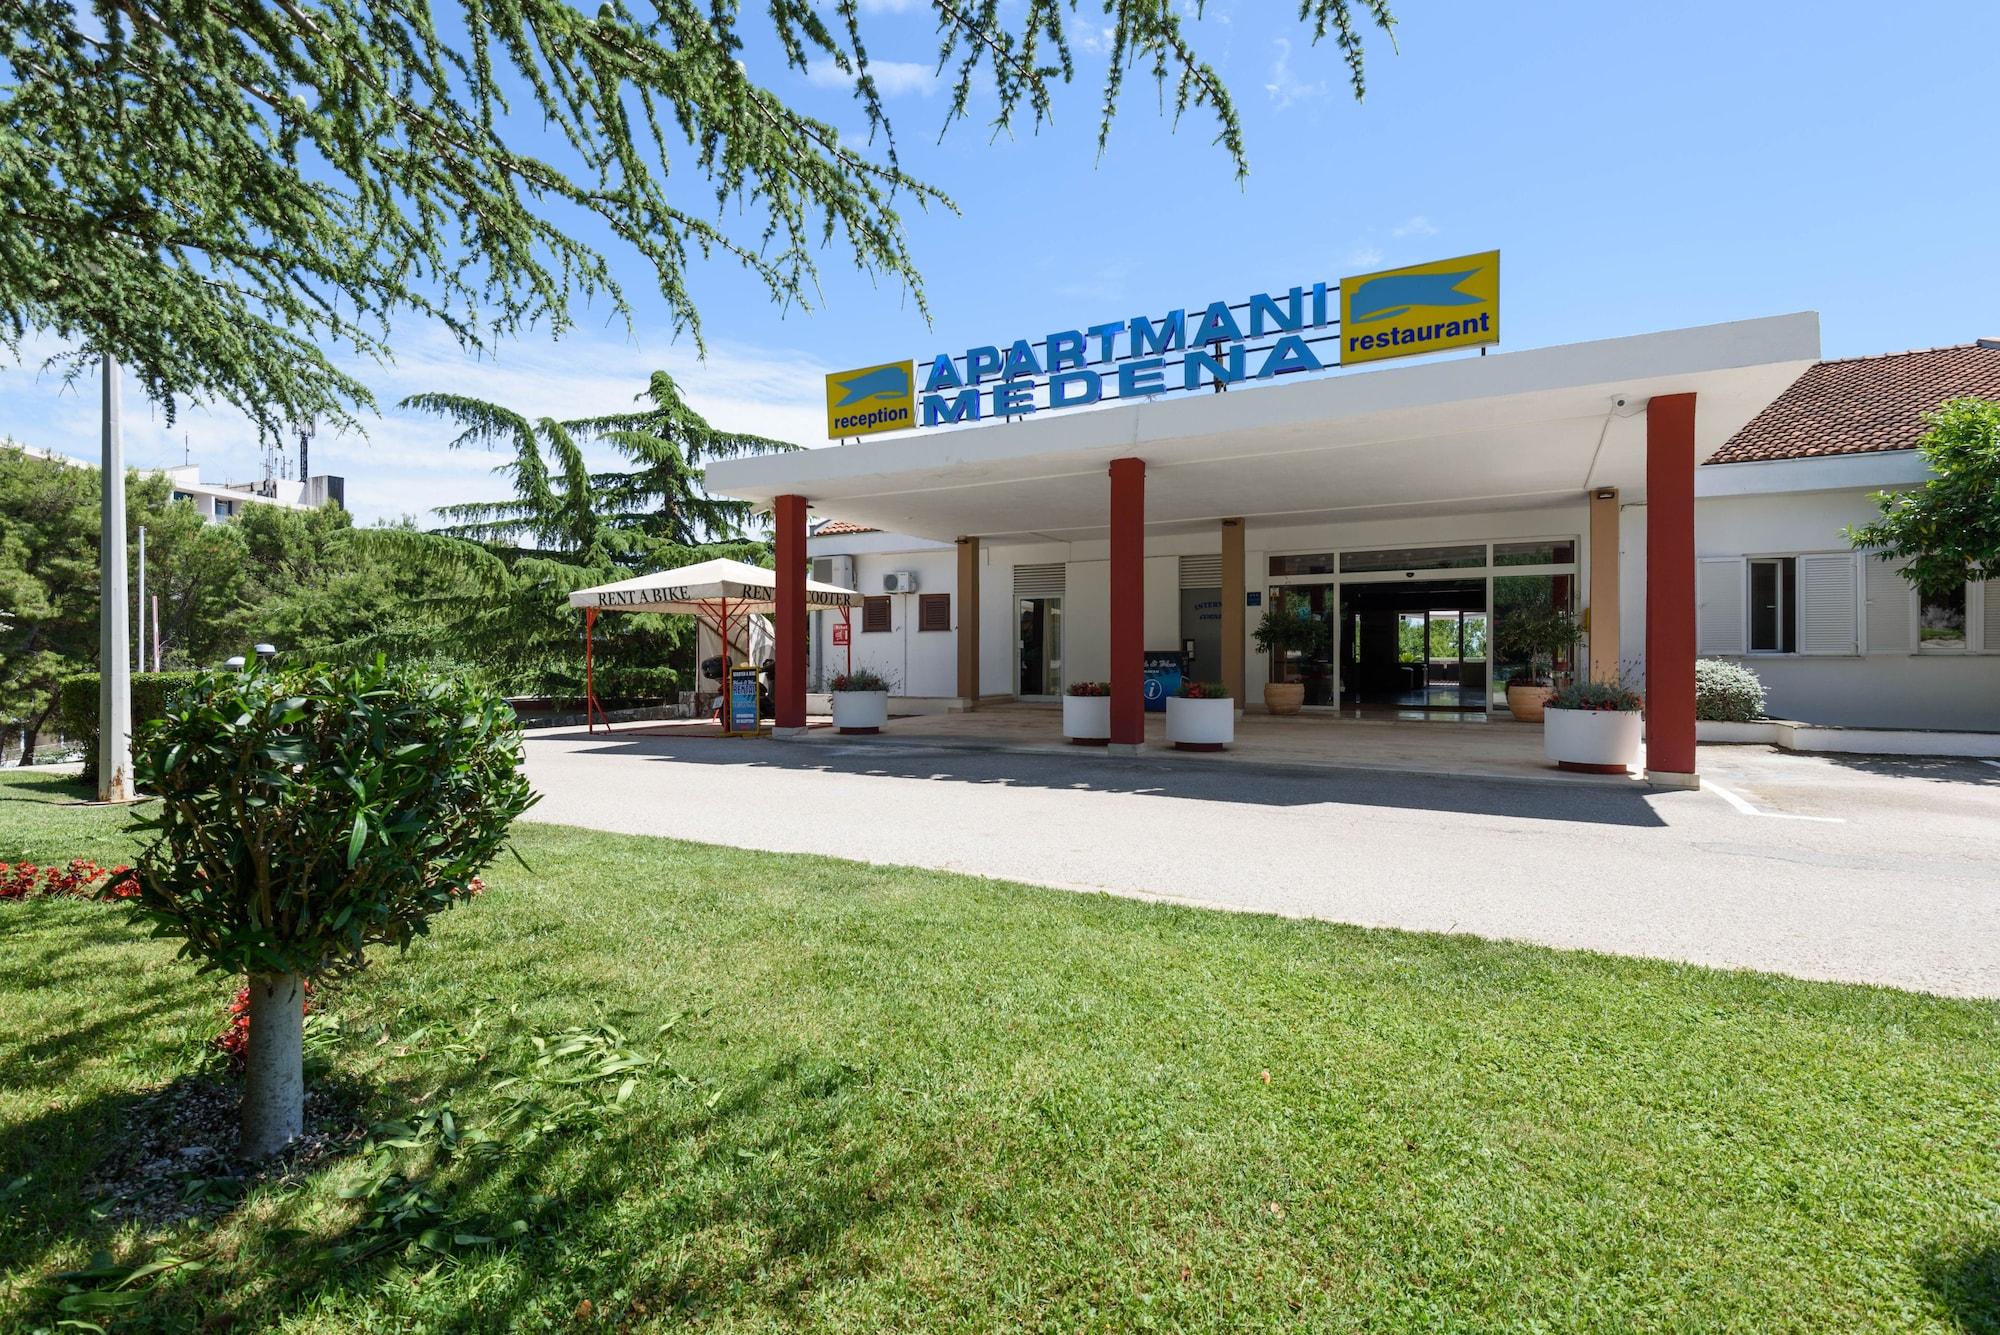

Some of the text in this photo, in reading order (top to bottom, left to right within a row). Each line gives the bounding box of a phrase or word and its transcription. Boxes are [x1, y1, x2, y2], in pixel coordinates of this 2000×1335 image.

[924, 282, 1327, 392] APARTMANI
[1349, 312, 1490, 352] restaurant
[922, 335, 1326, 428] MEDENA
[834, 406, 909, 430] reception
[598, 585, 691, 606] RENT A BIKE
[742, 584, 776, 601] REN
